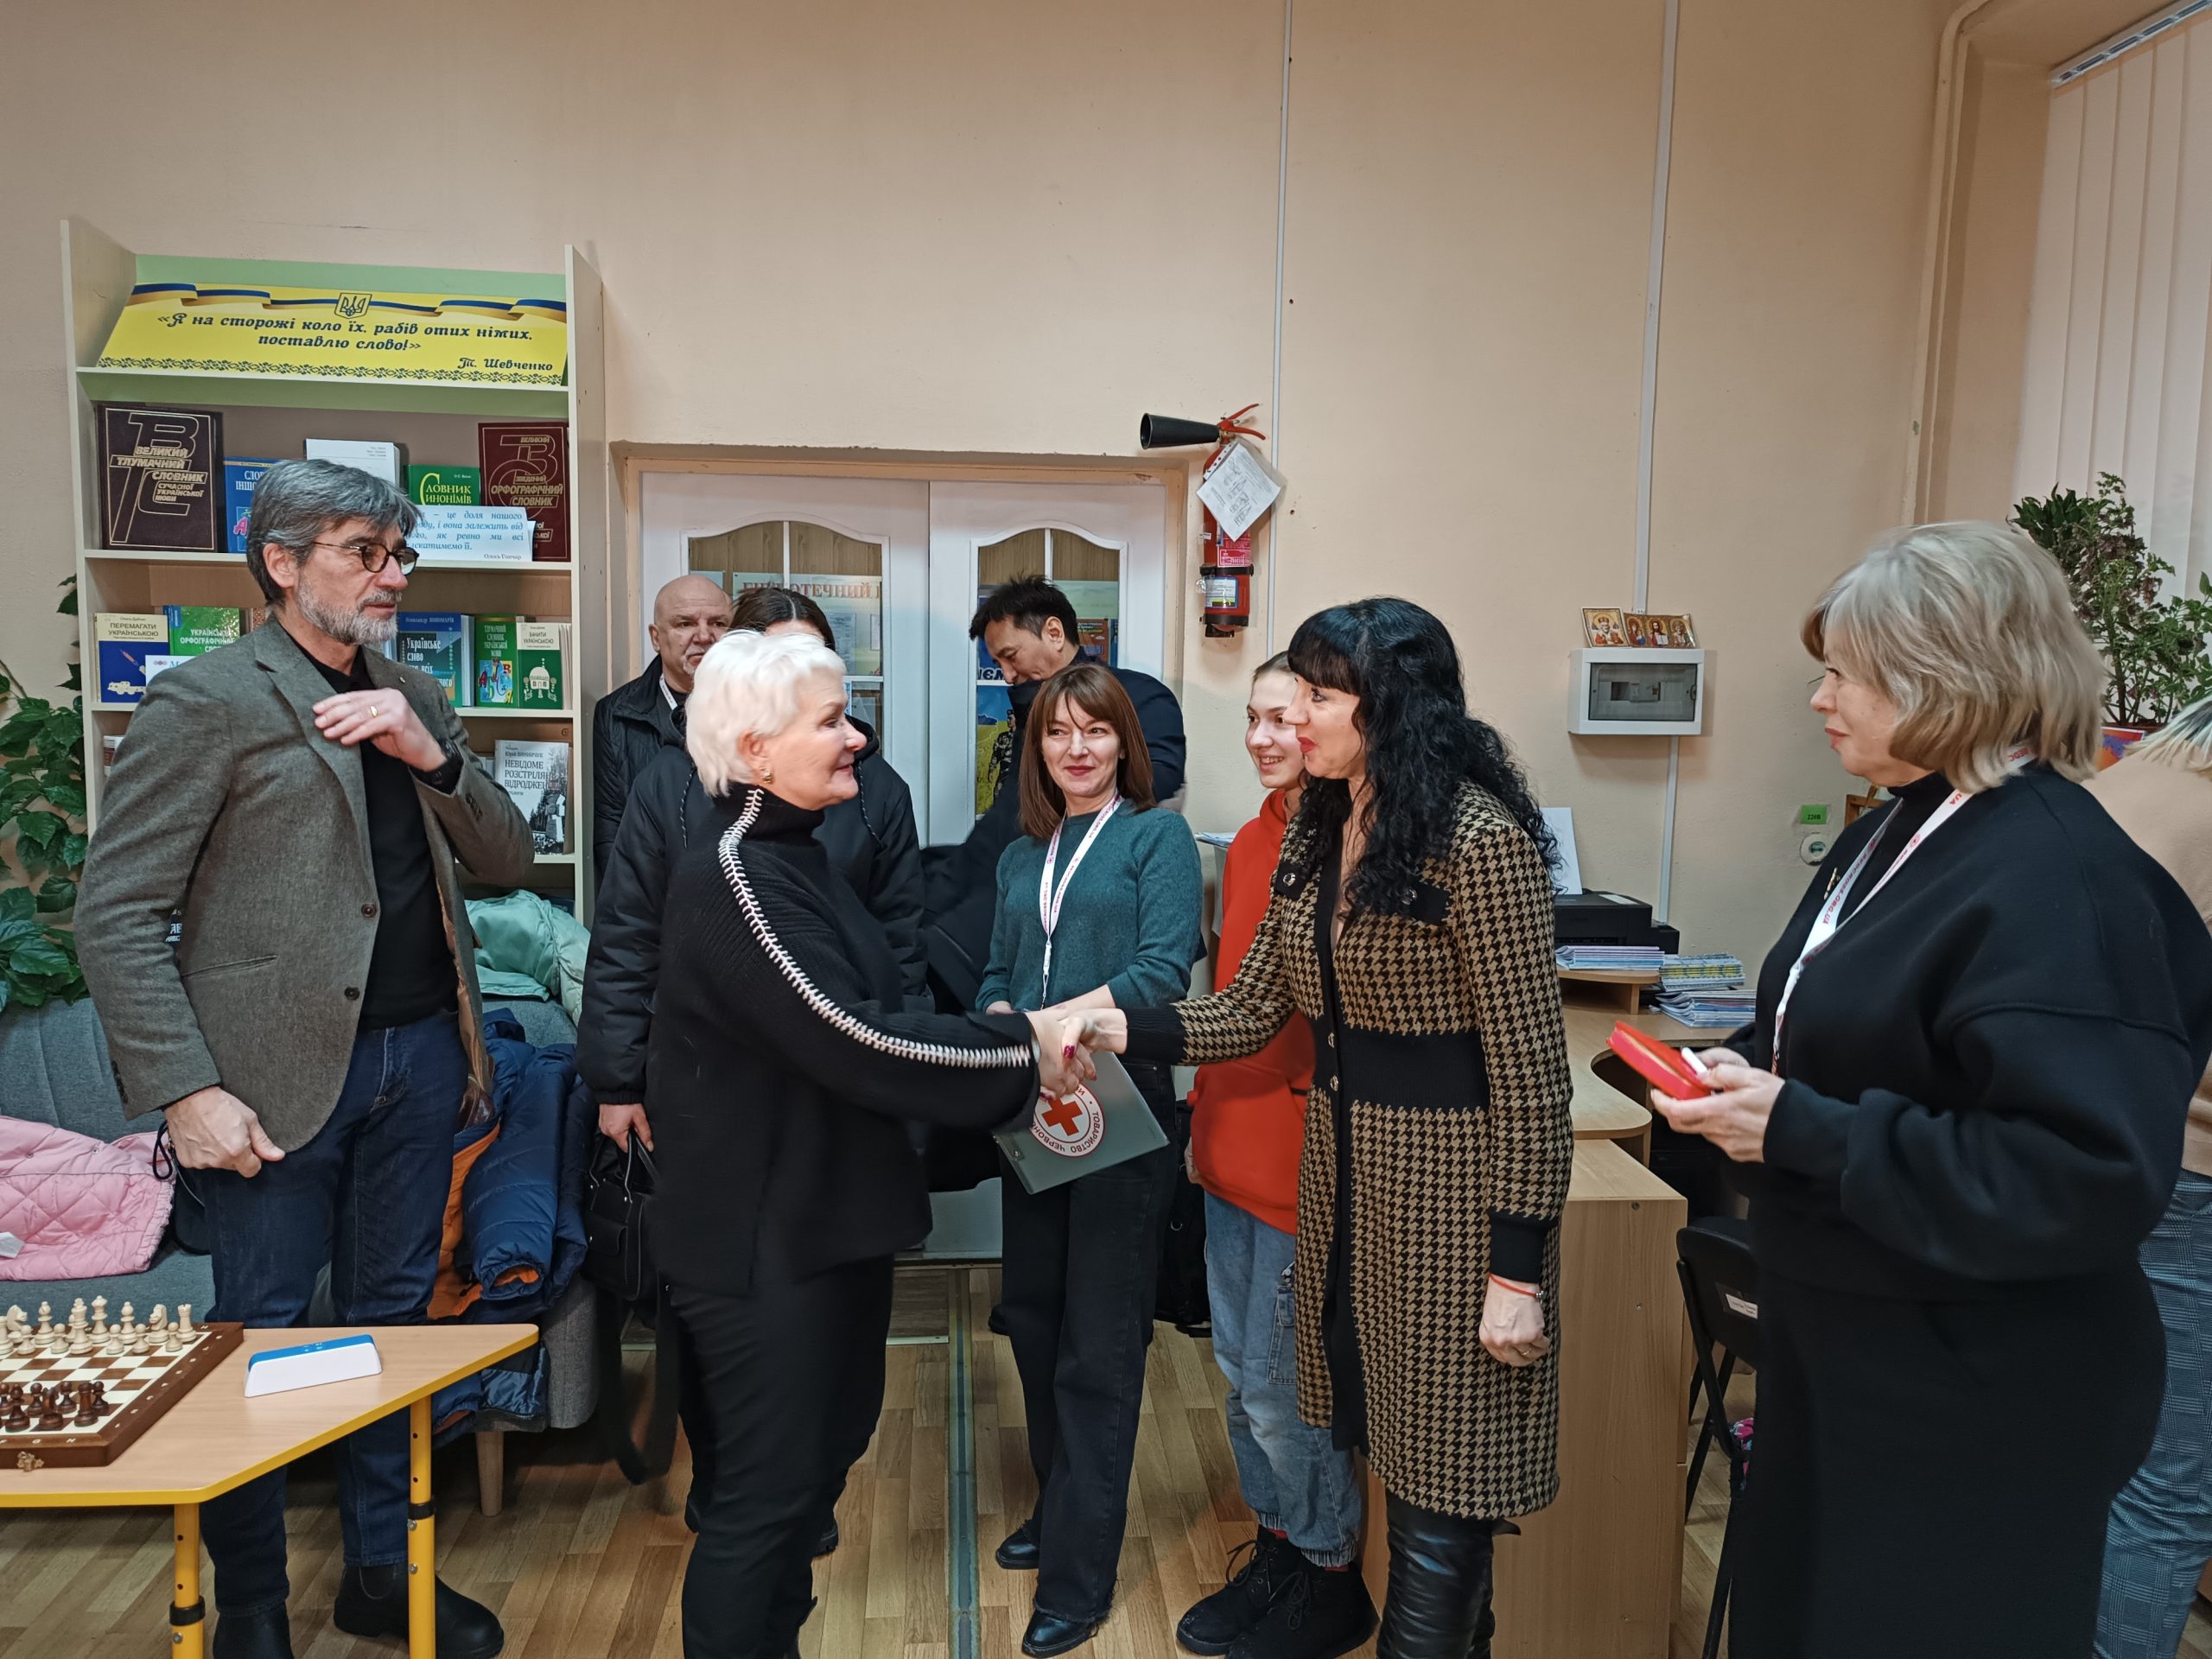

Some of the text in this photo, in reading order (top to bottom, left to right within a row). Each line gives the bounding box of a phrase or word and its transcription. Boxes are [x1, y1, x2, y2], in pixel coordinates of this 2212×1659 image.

[192, 316, 213, 327] на
[219, 317, 296, 330] сторожі
[302, 321, 341, 332] коло
[373, 323, 418, 335] рабів
[424, 327, 470, 337] отих
[258, 334, 421, 351] поставлю слово!»
[457, 357, 553, 371] Т. Шевченко
[135, 446, 188, 457] ВЕЛИКИЙ
[117, 456, 185, 469] ТЛУМАЧНИЙ
[152, 472, 204, 482] СЛОВНИК
[157, 482, 194, 491] СУЧАСНОЇ
[491, 483, 563, 495] ОРФОГРАФІЧНИЙ
[156, 489, 205, 498] УКРАЇНСЬКОЇ
[512, 497, 554, 506] СЛОВНИК
[464, 510, 484, 519] доля
[464, 521, 508, 530] залежить
[511, 521, 523, 530] від
[456, 532, 480, 542] ревно
[406, 637, 442, 652] Українське
[505, 759, 544, 769] НЕВІДОМЕ
[1070, 1111, 1101, 1154] ТОВАРИСТВО
